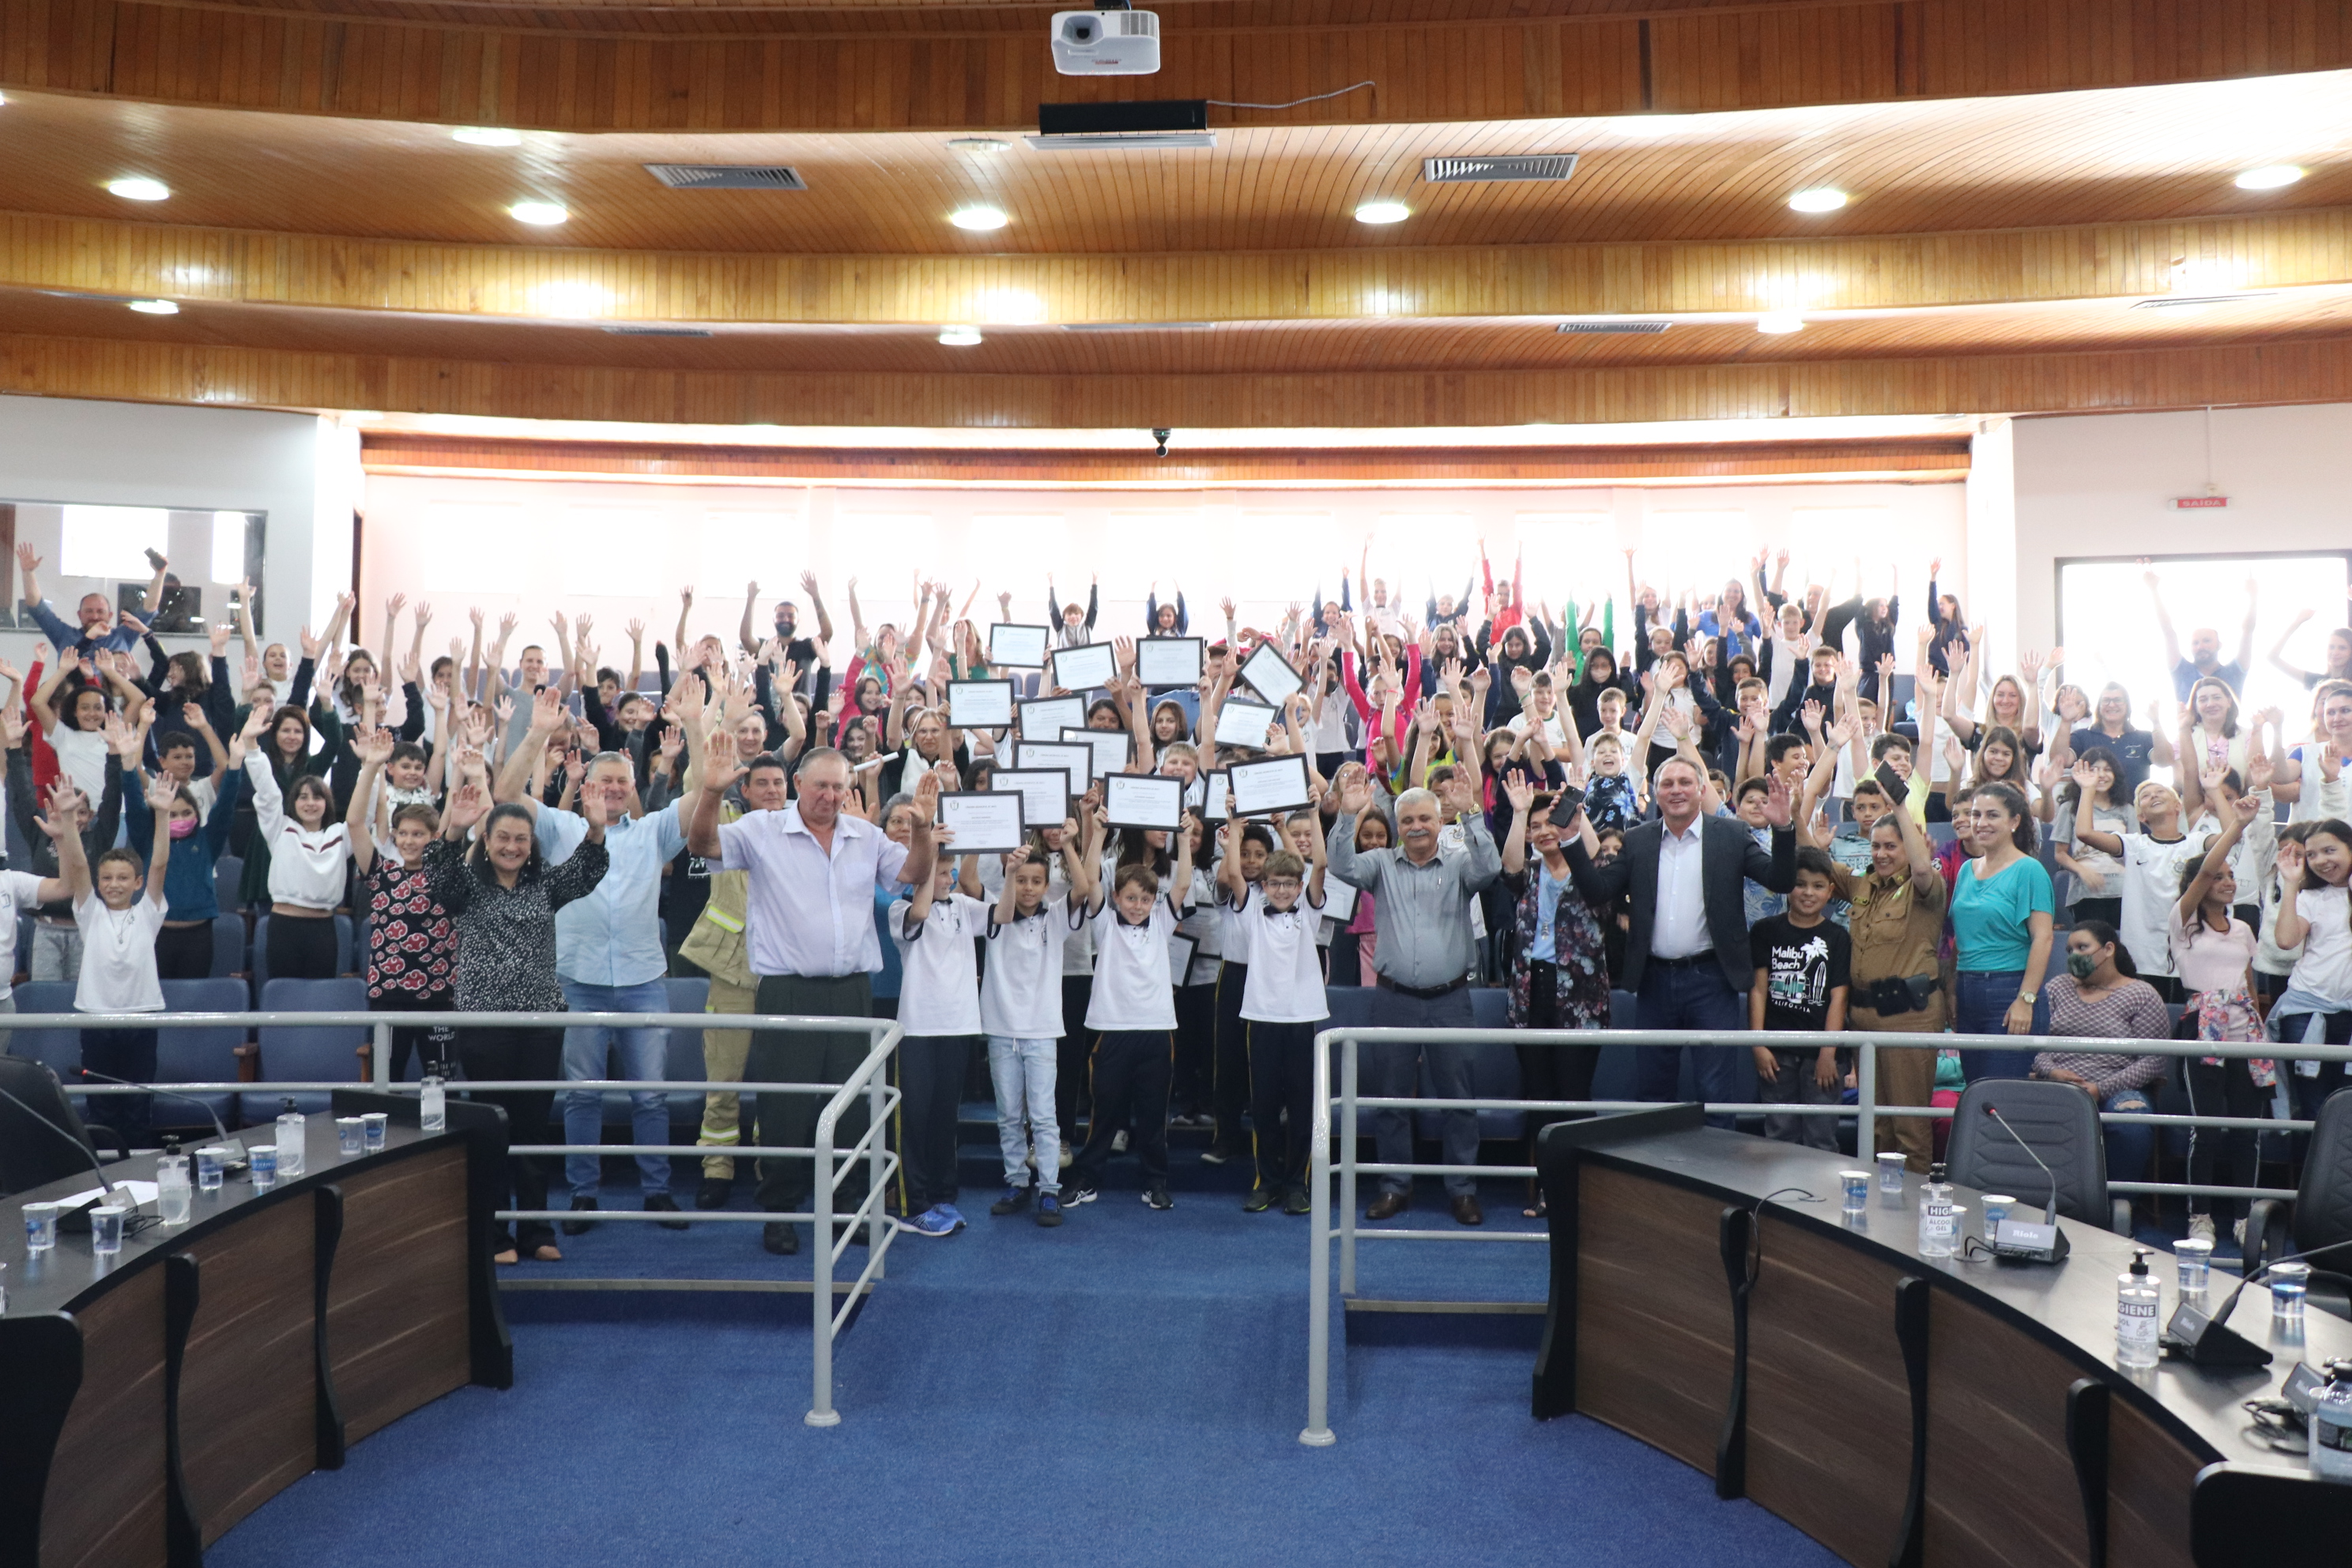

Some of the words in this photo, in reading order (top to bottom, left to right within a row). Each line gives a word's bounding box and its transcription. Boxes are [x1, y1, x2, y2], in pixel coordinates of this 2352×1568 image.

[1771, 945, 1804, 959] Malibu
[1771, 958, 1800, 970] Beach
[1771, 999, 1811, 1013] ALIFOIA
[2012, 1230, 2039, 1239] Riole
